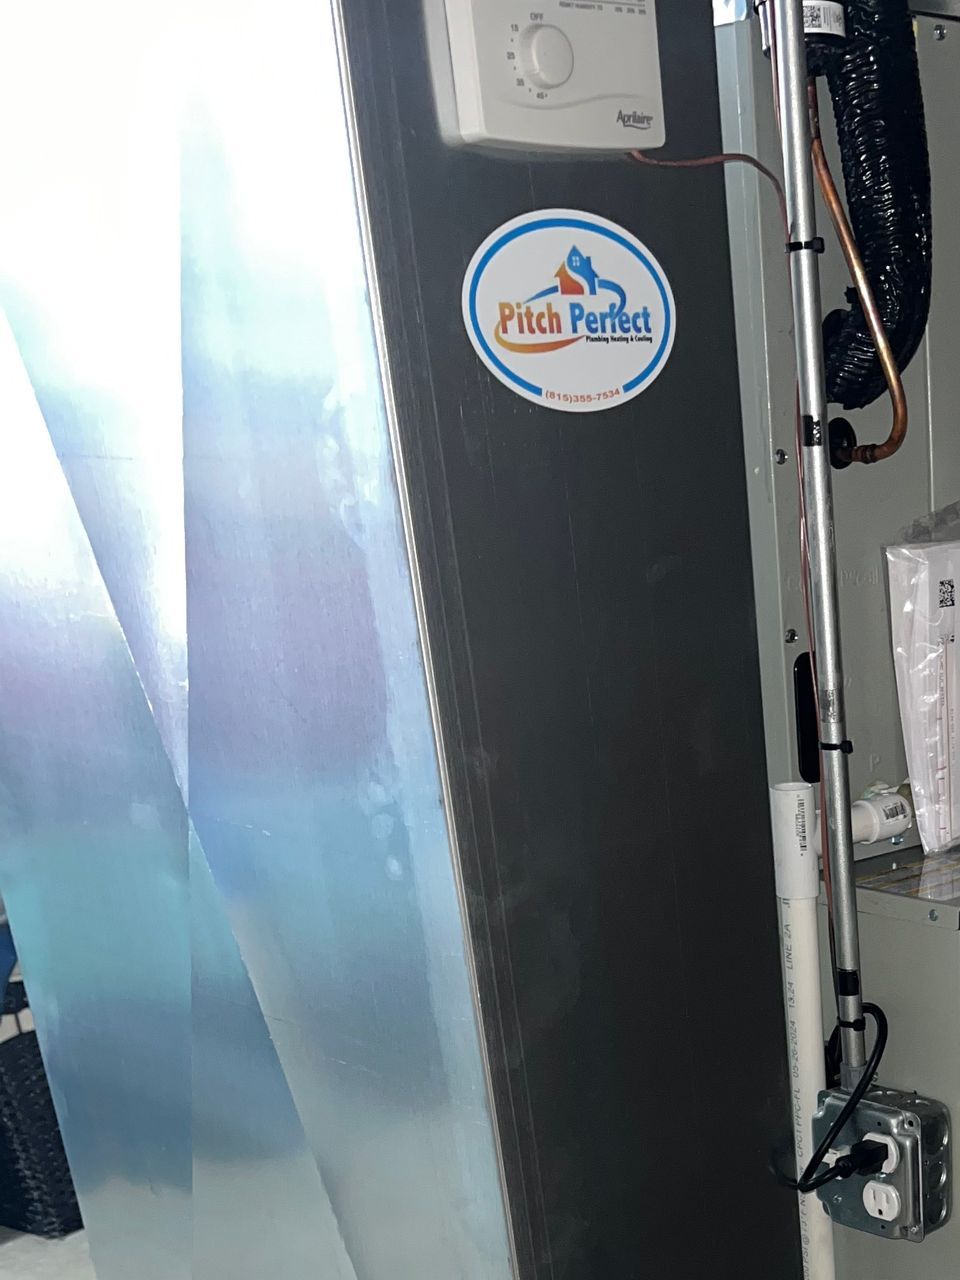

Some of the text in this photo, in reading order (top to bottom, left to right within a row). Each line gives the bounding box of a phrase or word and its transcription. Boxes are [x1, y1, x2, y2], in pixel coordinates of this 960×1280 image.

[530, 13, 544, 21] OFF
[510, 24, 519, 32] 15
[616, 109, 653, 127] Aprilaire
[498, 302, 652, 335] Pitch Perfect
[586, 335, 609, 344] Plumbing
[610, 336, 629, 344] Heating
[545, 387, 620, 404] (815)355-7534
[783, 923, 791, 937] 2A
[785, 943, 793, 970] LINE
